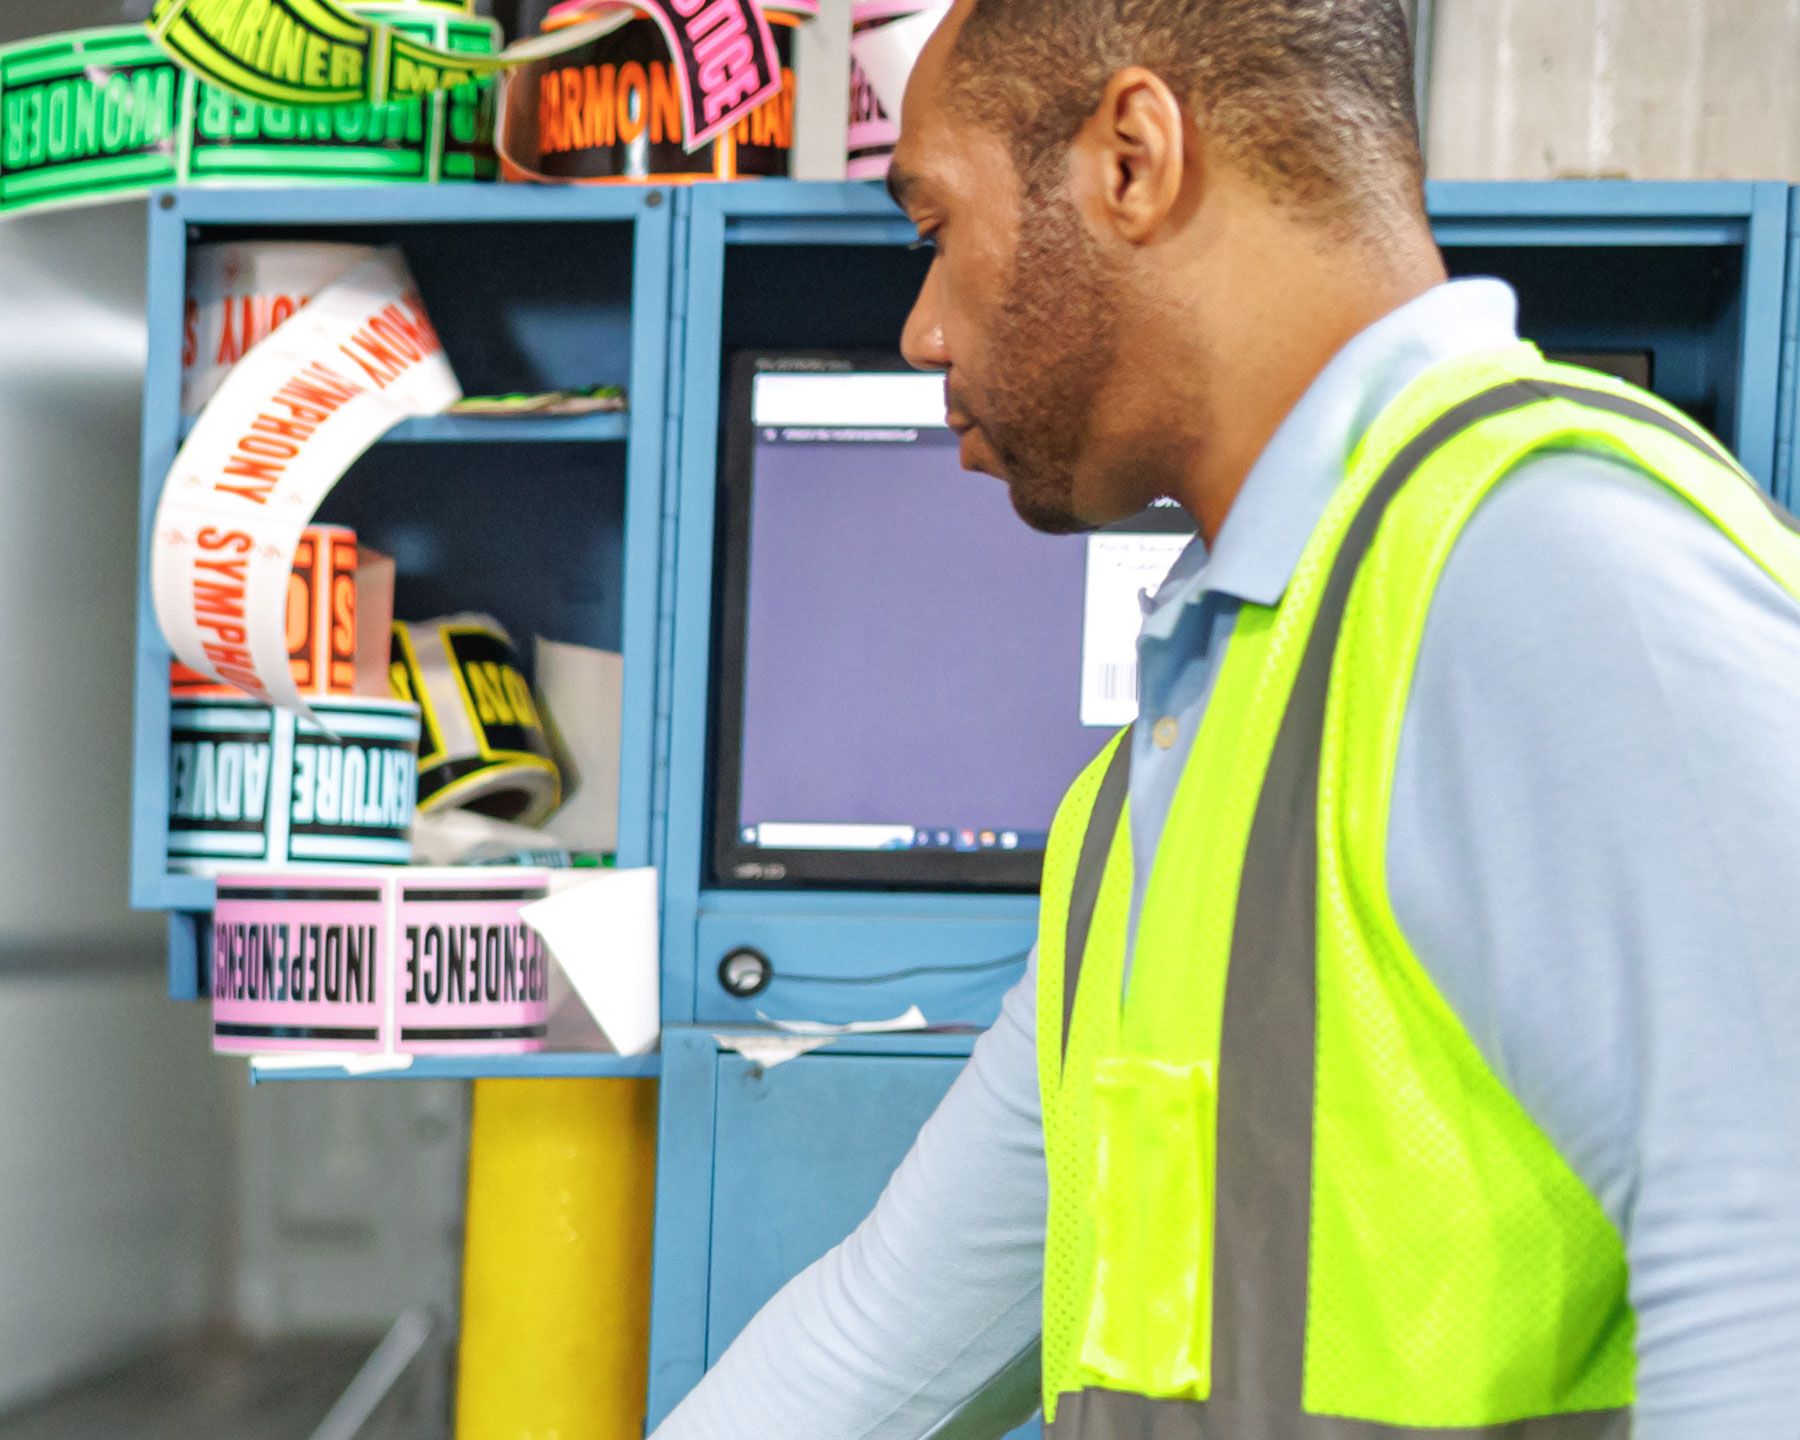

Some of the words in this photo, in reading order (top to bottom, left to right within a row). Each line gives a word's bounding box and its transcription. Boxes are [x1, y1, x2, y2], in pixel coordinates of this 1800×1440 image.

[3, 66, 174, 168] WONDER
[538, 61, 681, 153] ARMON
[293, 744, 414, 828] ENTURE
[216, 923, 377, 1004] INDEPENDENC
